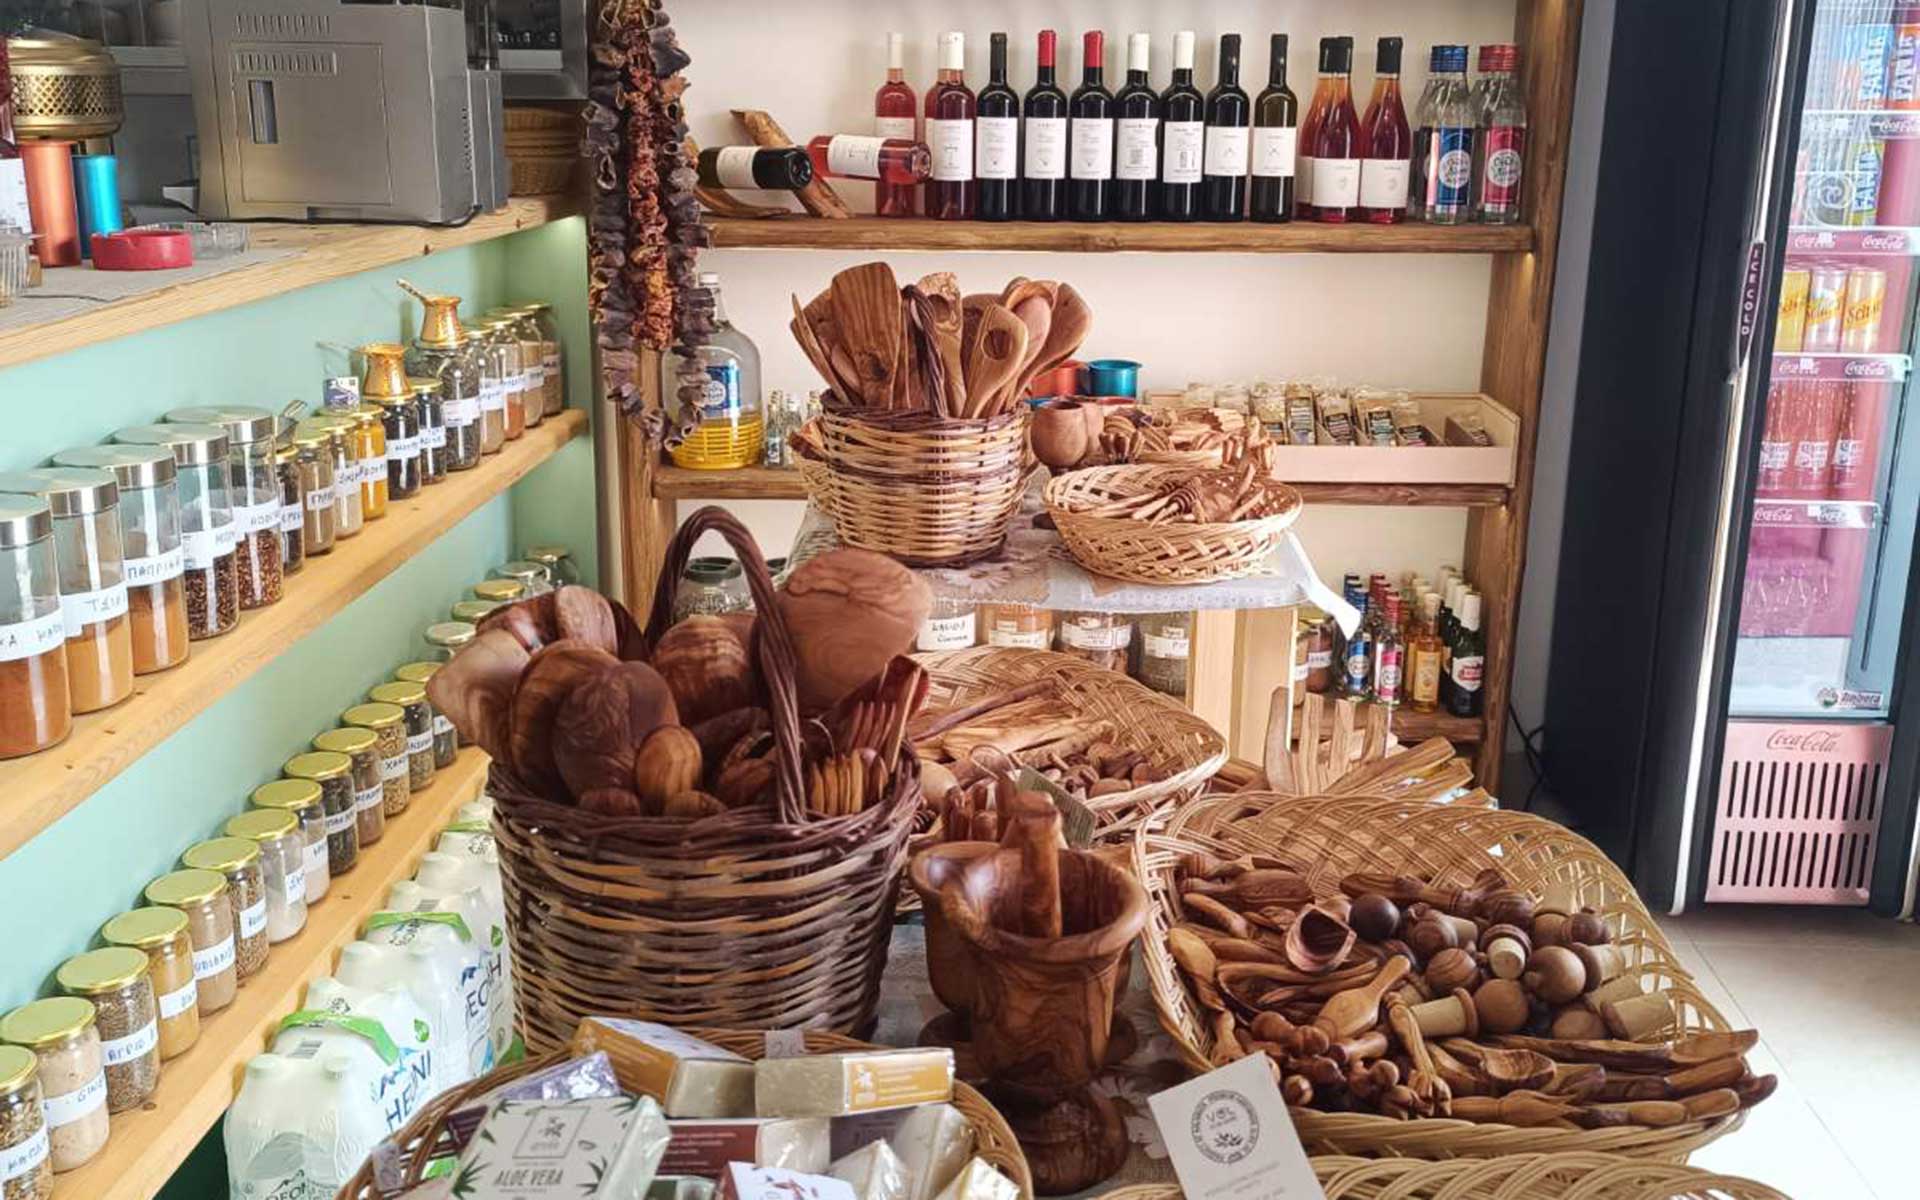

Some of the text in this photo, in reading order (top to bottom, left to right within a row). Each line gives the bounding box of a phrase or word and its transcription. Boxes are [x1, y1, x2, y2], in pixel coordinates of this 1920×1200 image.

[1741, 249, 1760, 336] ICE COLD
[494, 1168, 565, 1186] ALOE VERA
